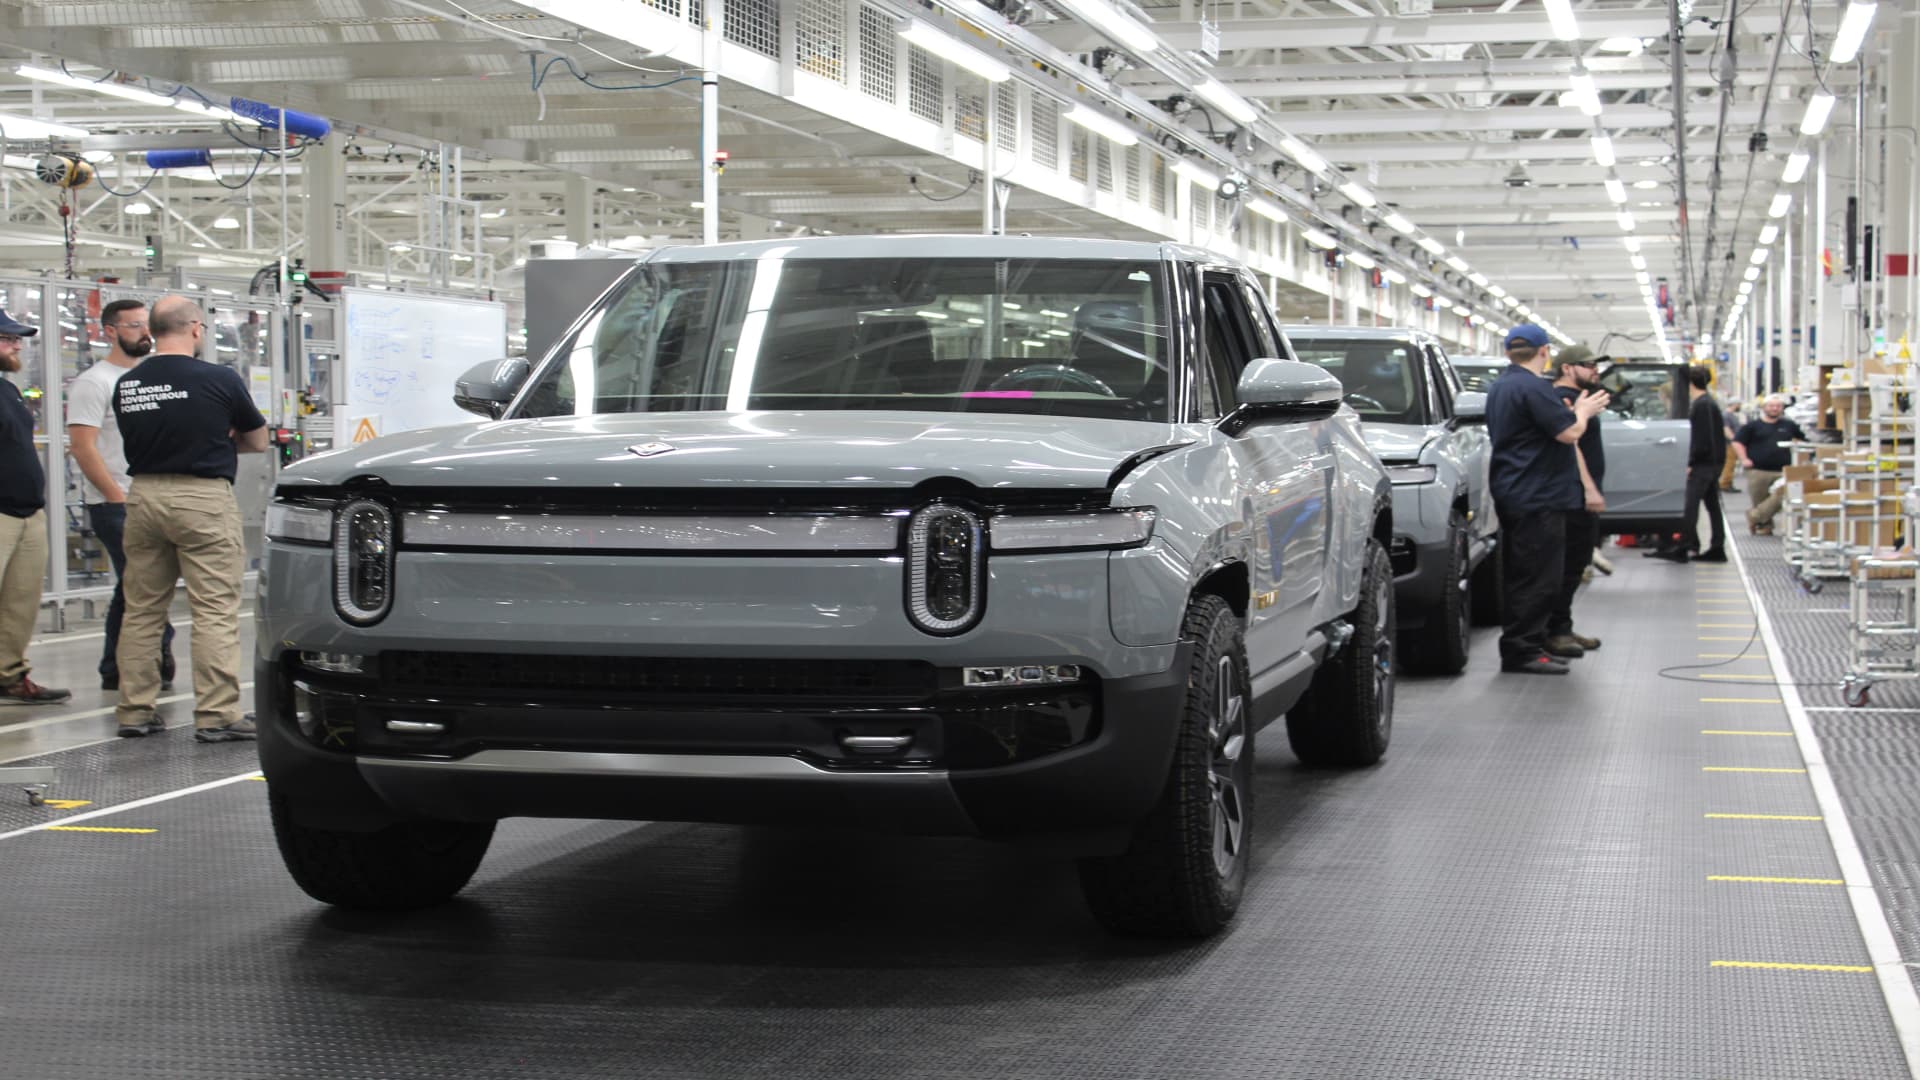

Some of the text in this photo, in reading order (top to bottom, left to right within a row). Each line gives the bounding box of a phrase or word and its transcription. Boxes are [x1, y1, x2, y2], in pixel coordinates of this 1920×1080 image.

[120, 380, 141, 389] KEEP
[120, 384, 172, 396] THE WORLD
[120, 391, 189, 405] ADVENTUROUS
